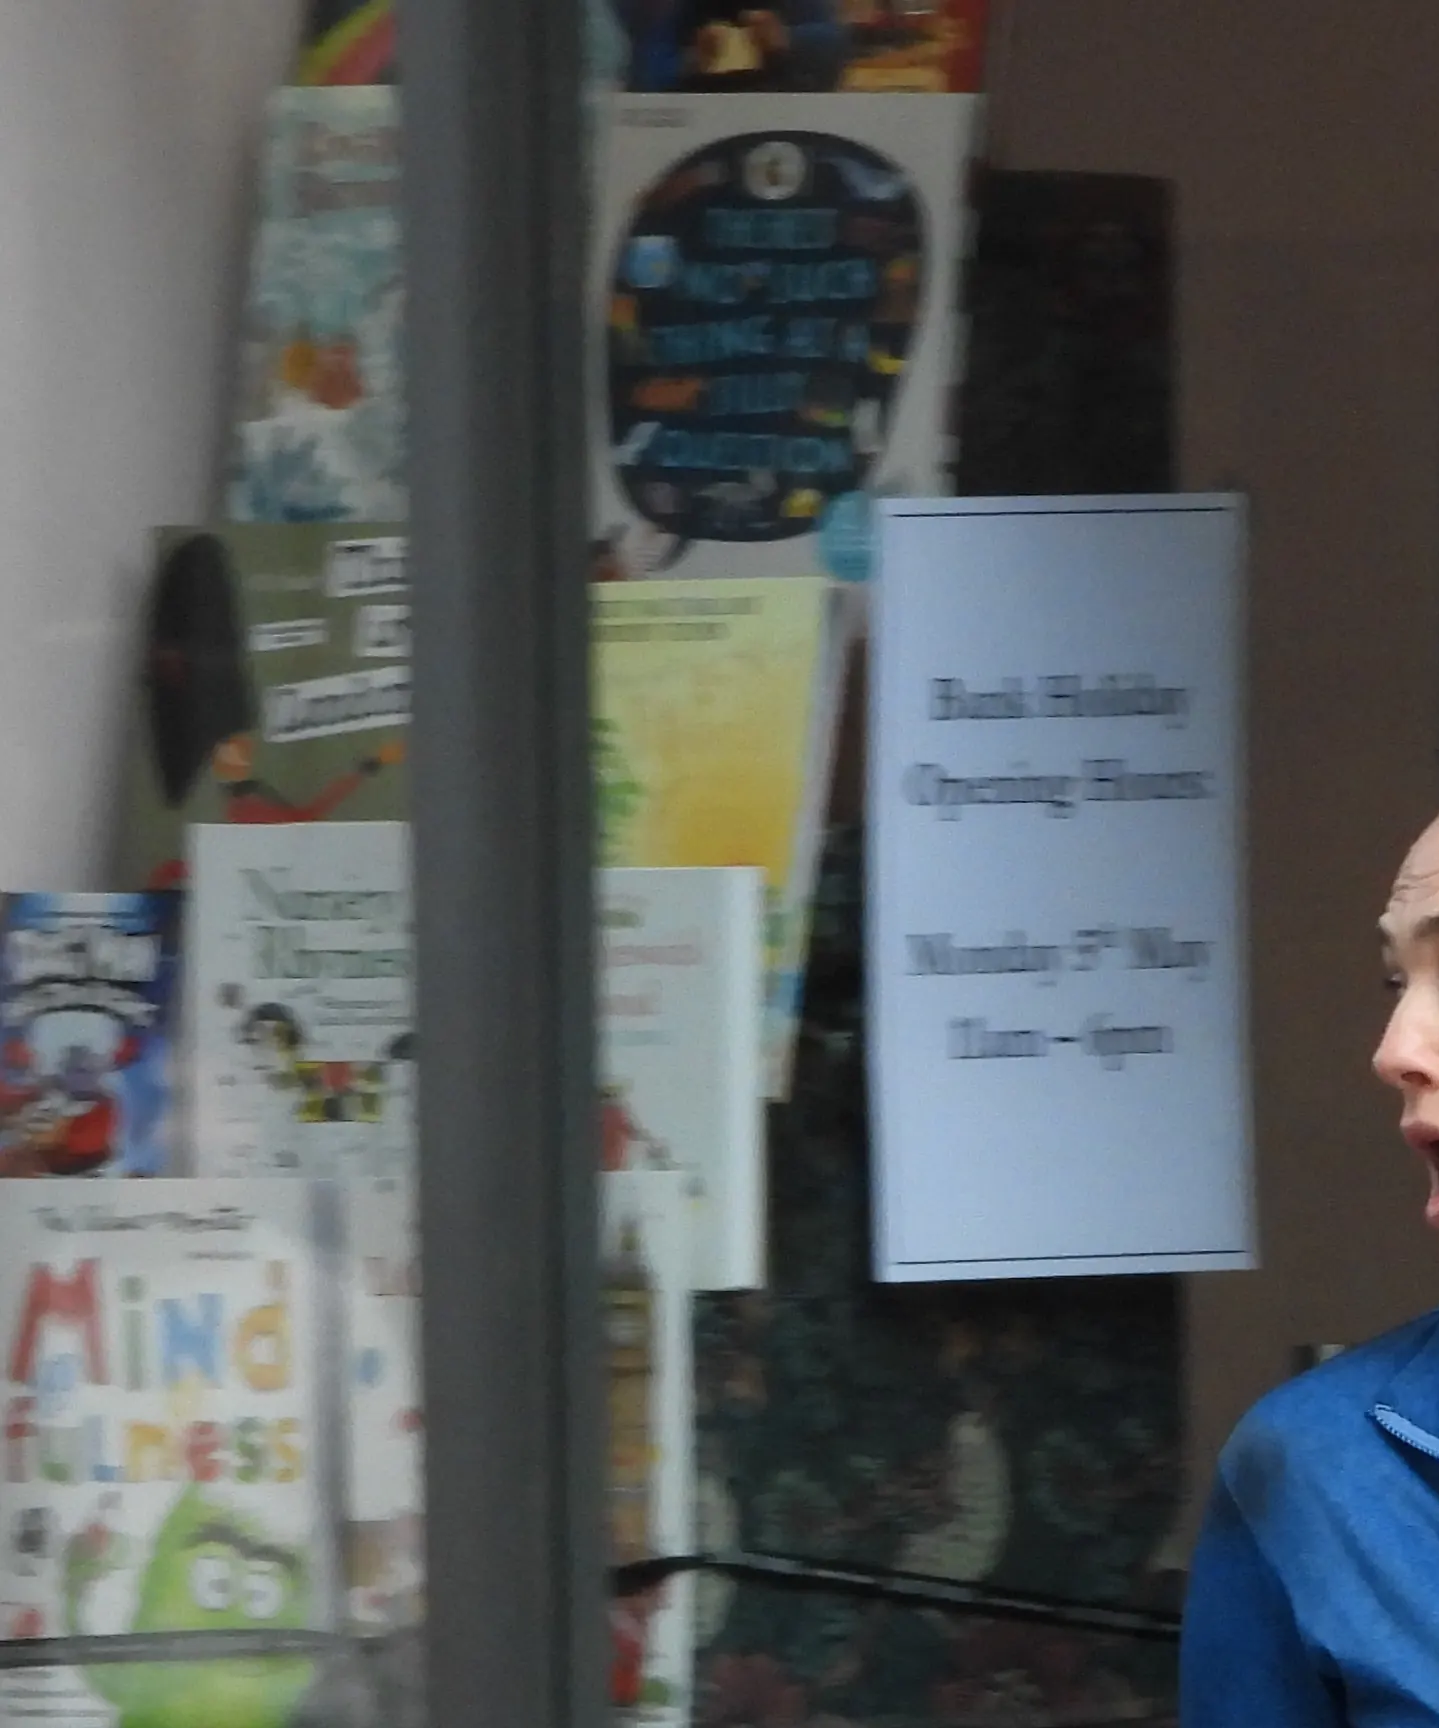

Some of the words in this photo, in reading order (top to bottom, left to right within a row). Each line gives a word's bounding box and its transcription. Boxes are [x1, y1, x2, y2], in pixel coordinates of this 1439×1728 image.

[928, 677, 1026, 720] Bank
[1037, 672, 1187, 729] Holiday
[905, 763, 1075, 820] Opening
[906, 932, 1062, 985] Monday
[1125, 927, 1212, 982] May
